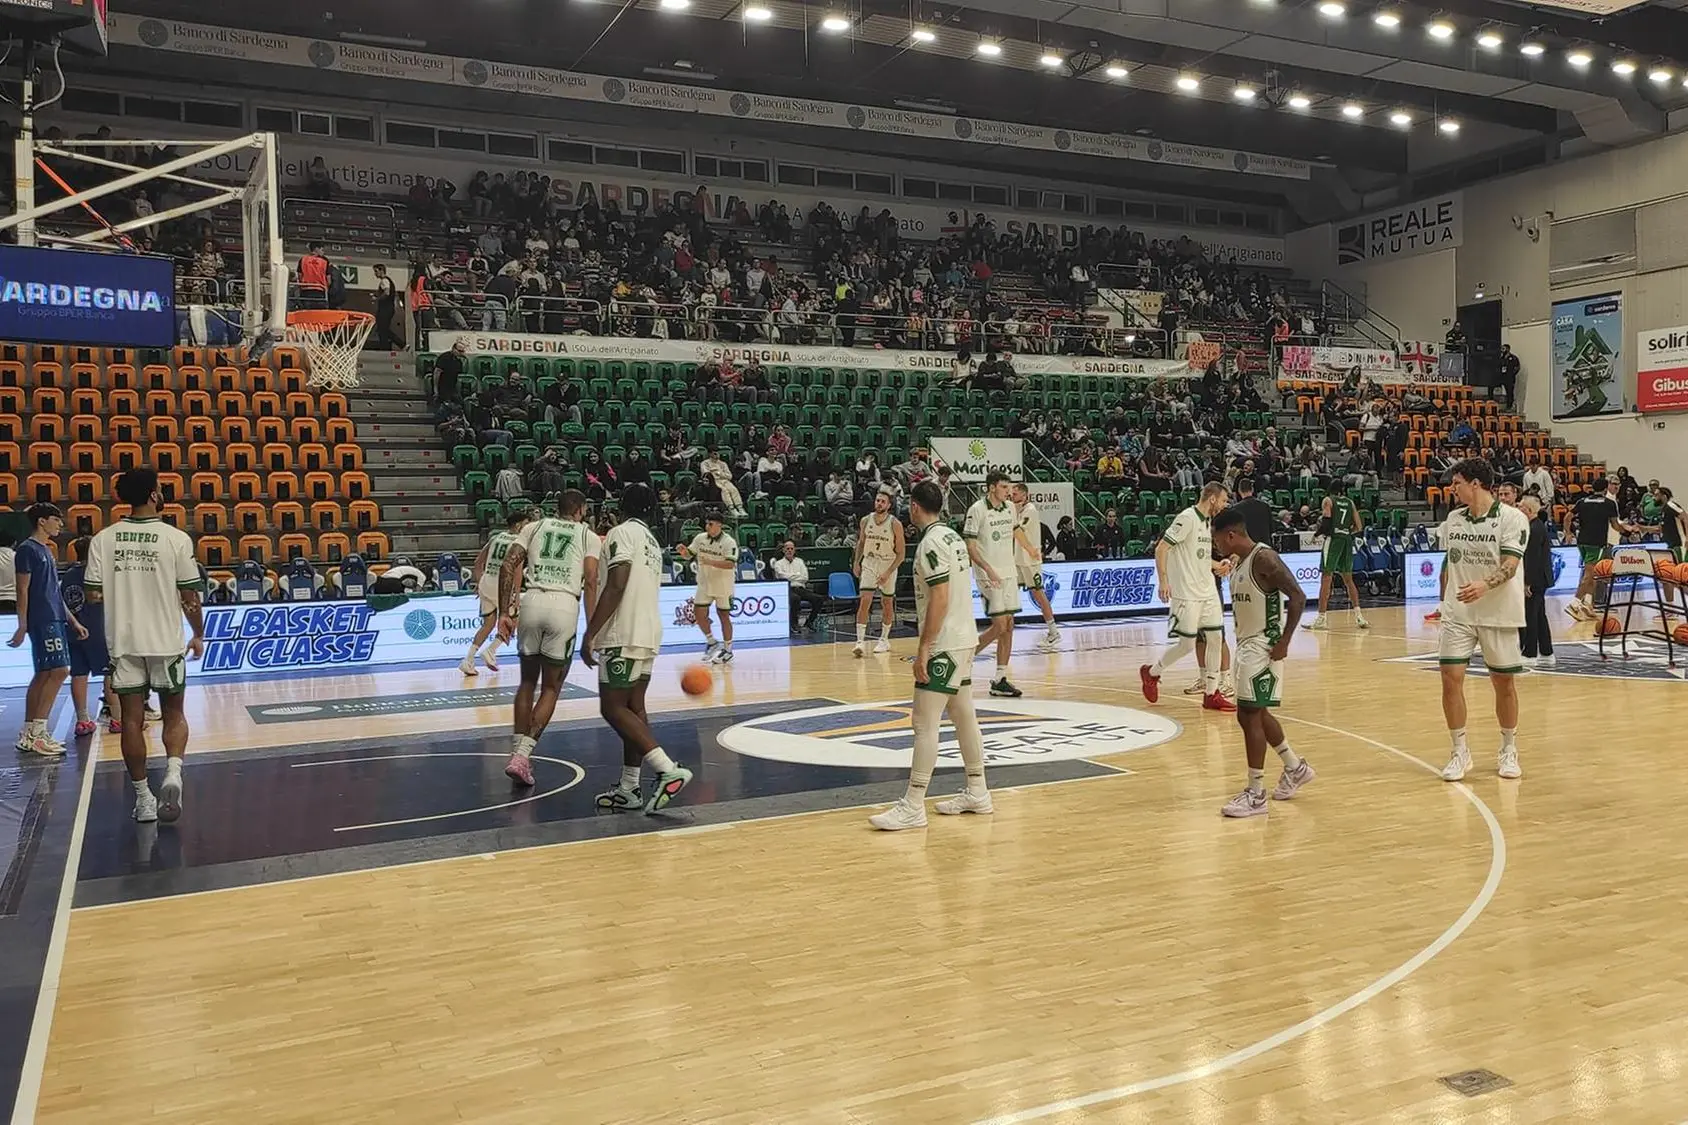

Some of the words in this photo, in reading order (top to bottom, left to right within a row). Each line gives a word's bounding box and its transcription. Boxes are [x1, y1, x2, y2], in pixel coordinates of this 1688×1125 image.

[173, 23, 213, 41] Banco
[228, 31, 289, 50] Sardegna
[339, 46, 376, 60] Banco
[390, 52, 444, 70] Sardegna
[491, 65, 524, 79] Banco
[538, 69, 587, 87] Sardegna
[628, 81, 659, 95] Banco
[671, 87, 716, 102] Sardegna
[1371, 200, 1453, 241] REALE
[1371, 226, 1453, 258] MUTUA
[476, 337, 568, 353] SARDEGNA
[713, 348, 792, 362] SARDEGNA
[1085, 362, 1145, 374] SARDEGNA
[1340, 508, 1347, 525] 7
[115, 532, 159, 544] RENFRO
[540, 531, 574, 559] 17
[1449, 532, 1497, 543] SARDINIA
[1620, 555, 1645, 565] Wilson
[1071, 569, 1090, 590] IL
[1089, 566, 1155, 588] BASKET
[1071, 589, 1093, 608] IN
[1093, 584, 1155, 607] CLASSE
[203, 610, 236, 640] IL
[241, 604, 377, 638] BASKET
[45, 637, 63, 652] 56
[202, 640, 248, 671] IN
[248, 630, 380, 668] CLASSE
